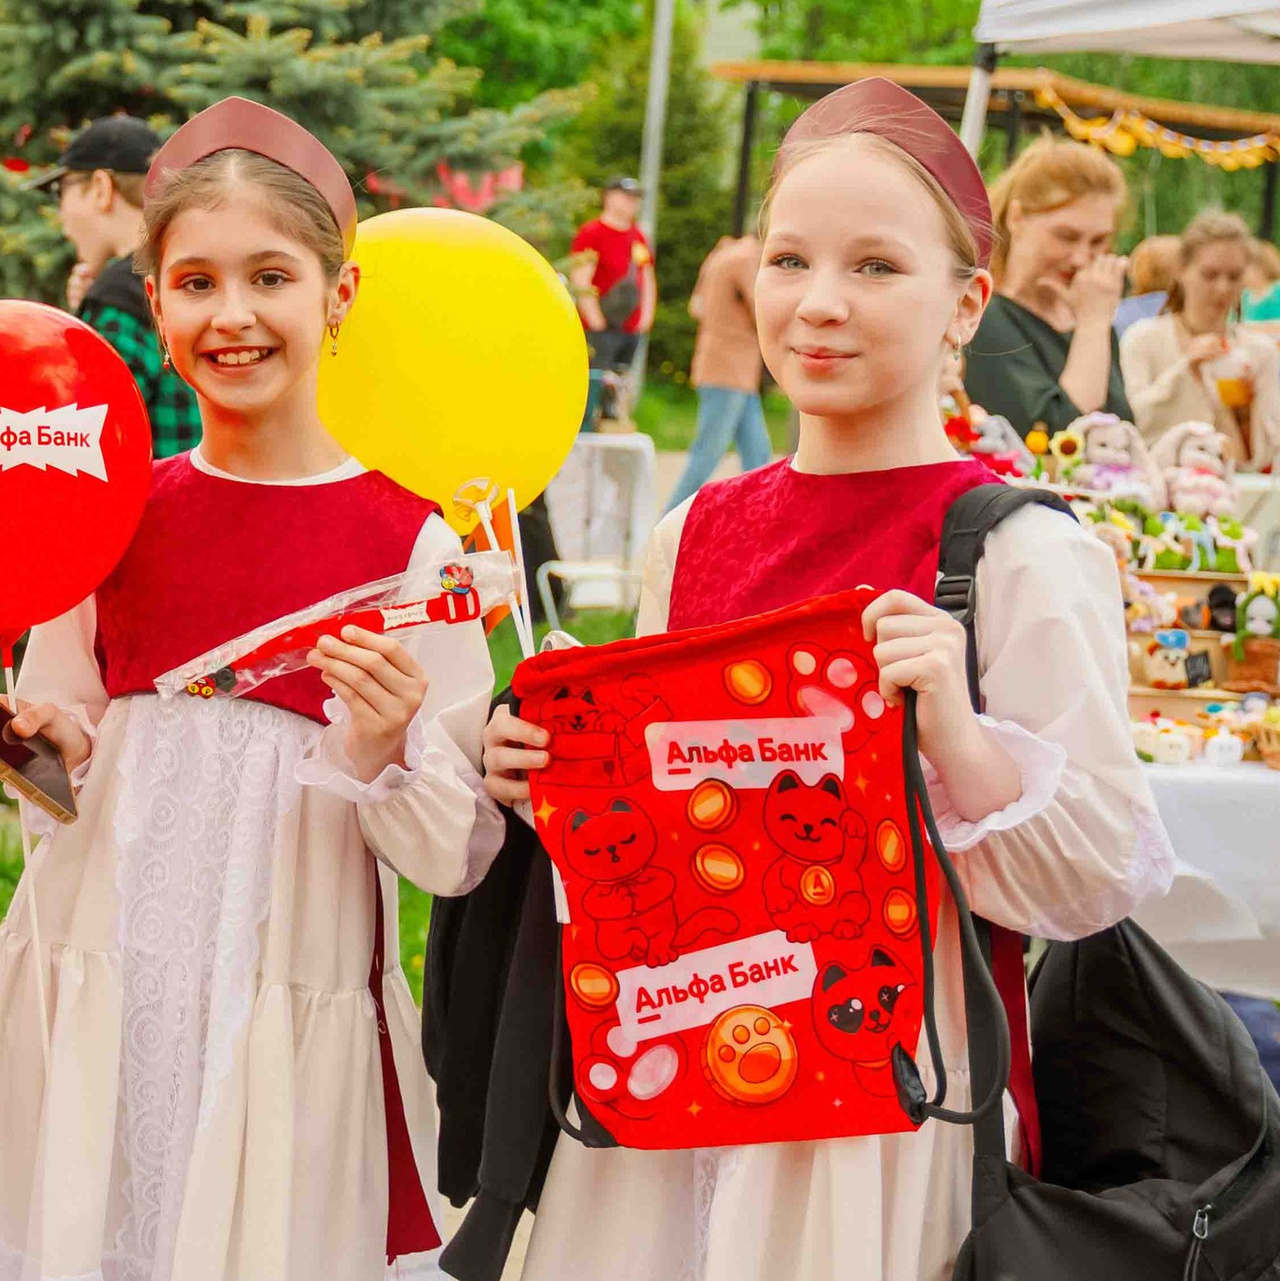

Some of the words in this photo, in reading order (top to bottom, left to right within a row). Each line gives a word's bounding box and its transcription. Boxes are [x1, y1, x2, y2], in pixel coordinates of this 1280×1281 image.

[37, 425, 91, 448] Банк
[667, 738, 755, 775] Альфа
[757, 737, 829, 763] Банк
[635, 973, 727, 1025] Альфа
[728, 954, 800, 988] Банк
